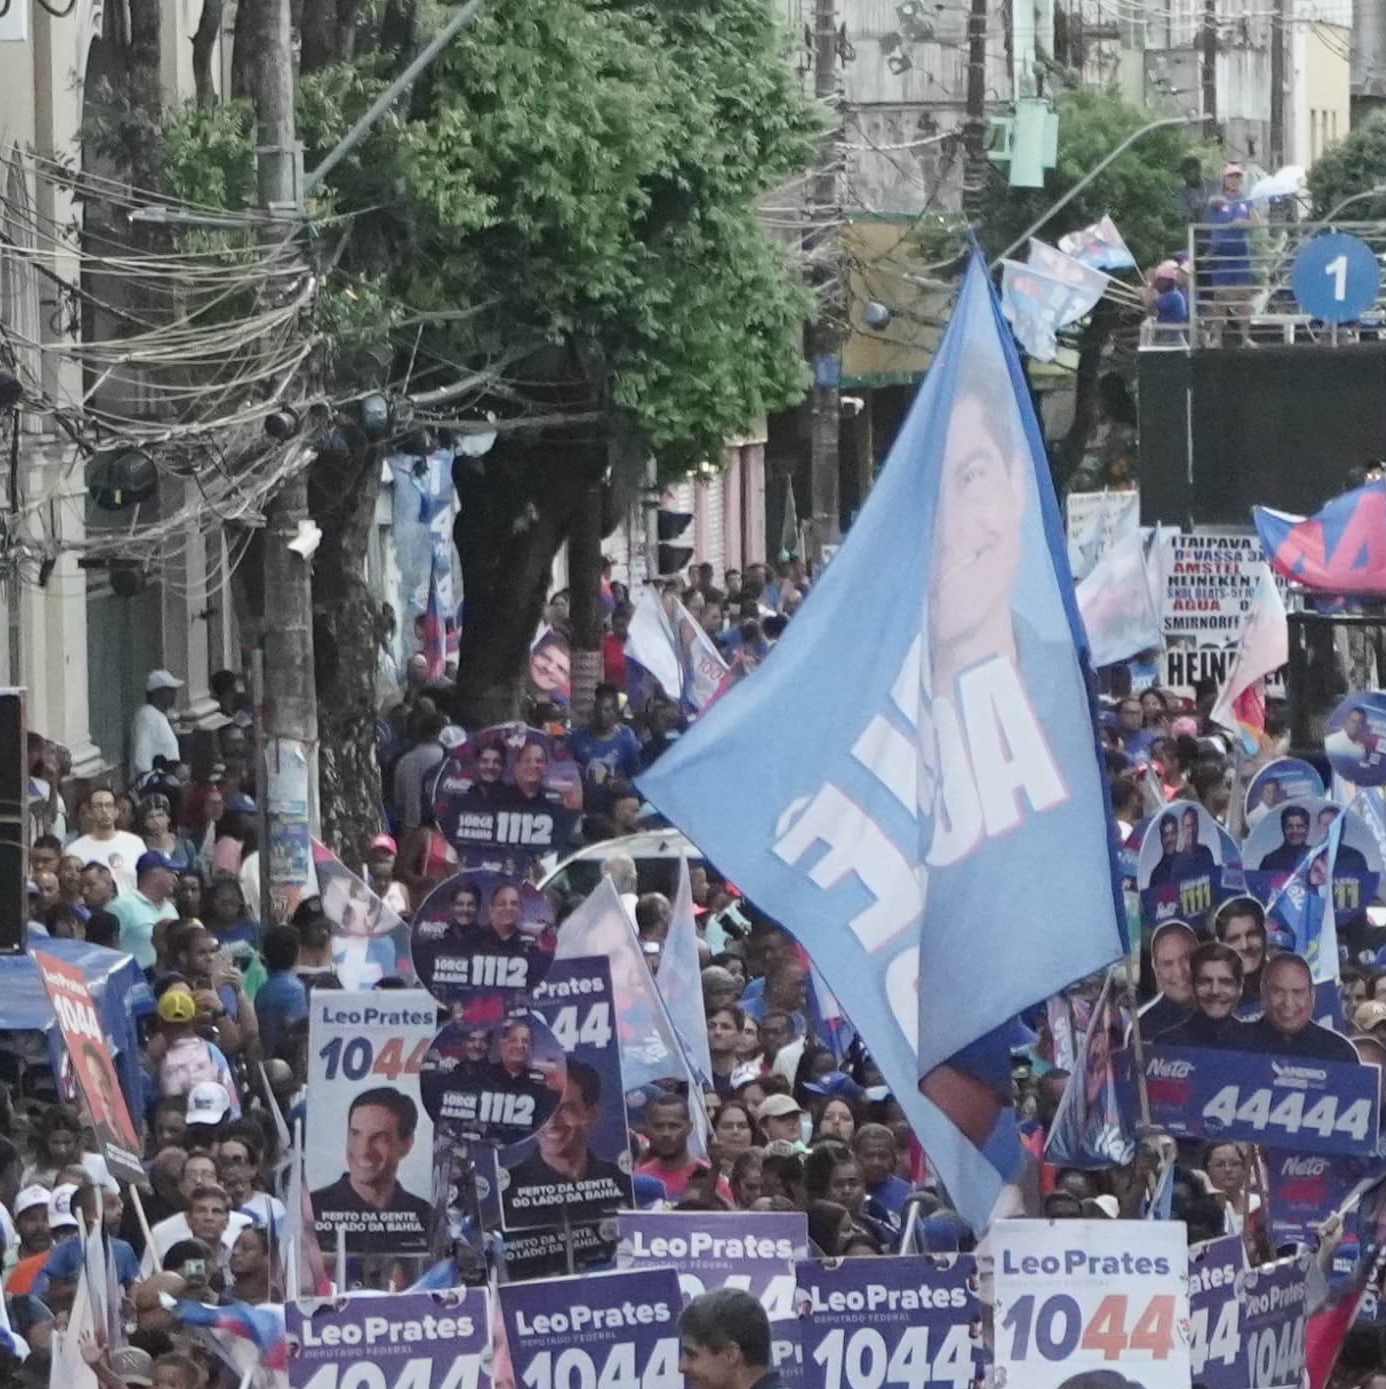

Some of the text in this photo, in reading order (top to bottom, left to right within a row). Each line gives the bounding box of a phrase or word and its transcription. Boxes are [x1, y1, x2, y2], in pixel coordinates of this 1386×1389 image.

[1325, 256, 1348, 301] 1
[1171, 536, 1251, 549] ITAIPAVA
[1173, 563, 1241, 574] AMSTEL
[495, 811, 554, 845] 1112
[471, 954, 529, 988] 1112
[1146, 1057, 1196, 1079] Neto
[479, 1091, 536, 1126] 1112
[1203, 1084, 1373, 1141] 44444
[1001, 1293, 1177, 1362] 1044
